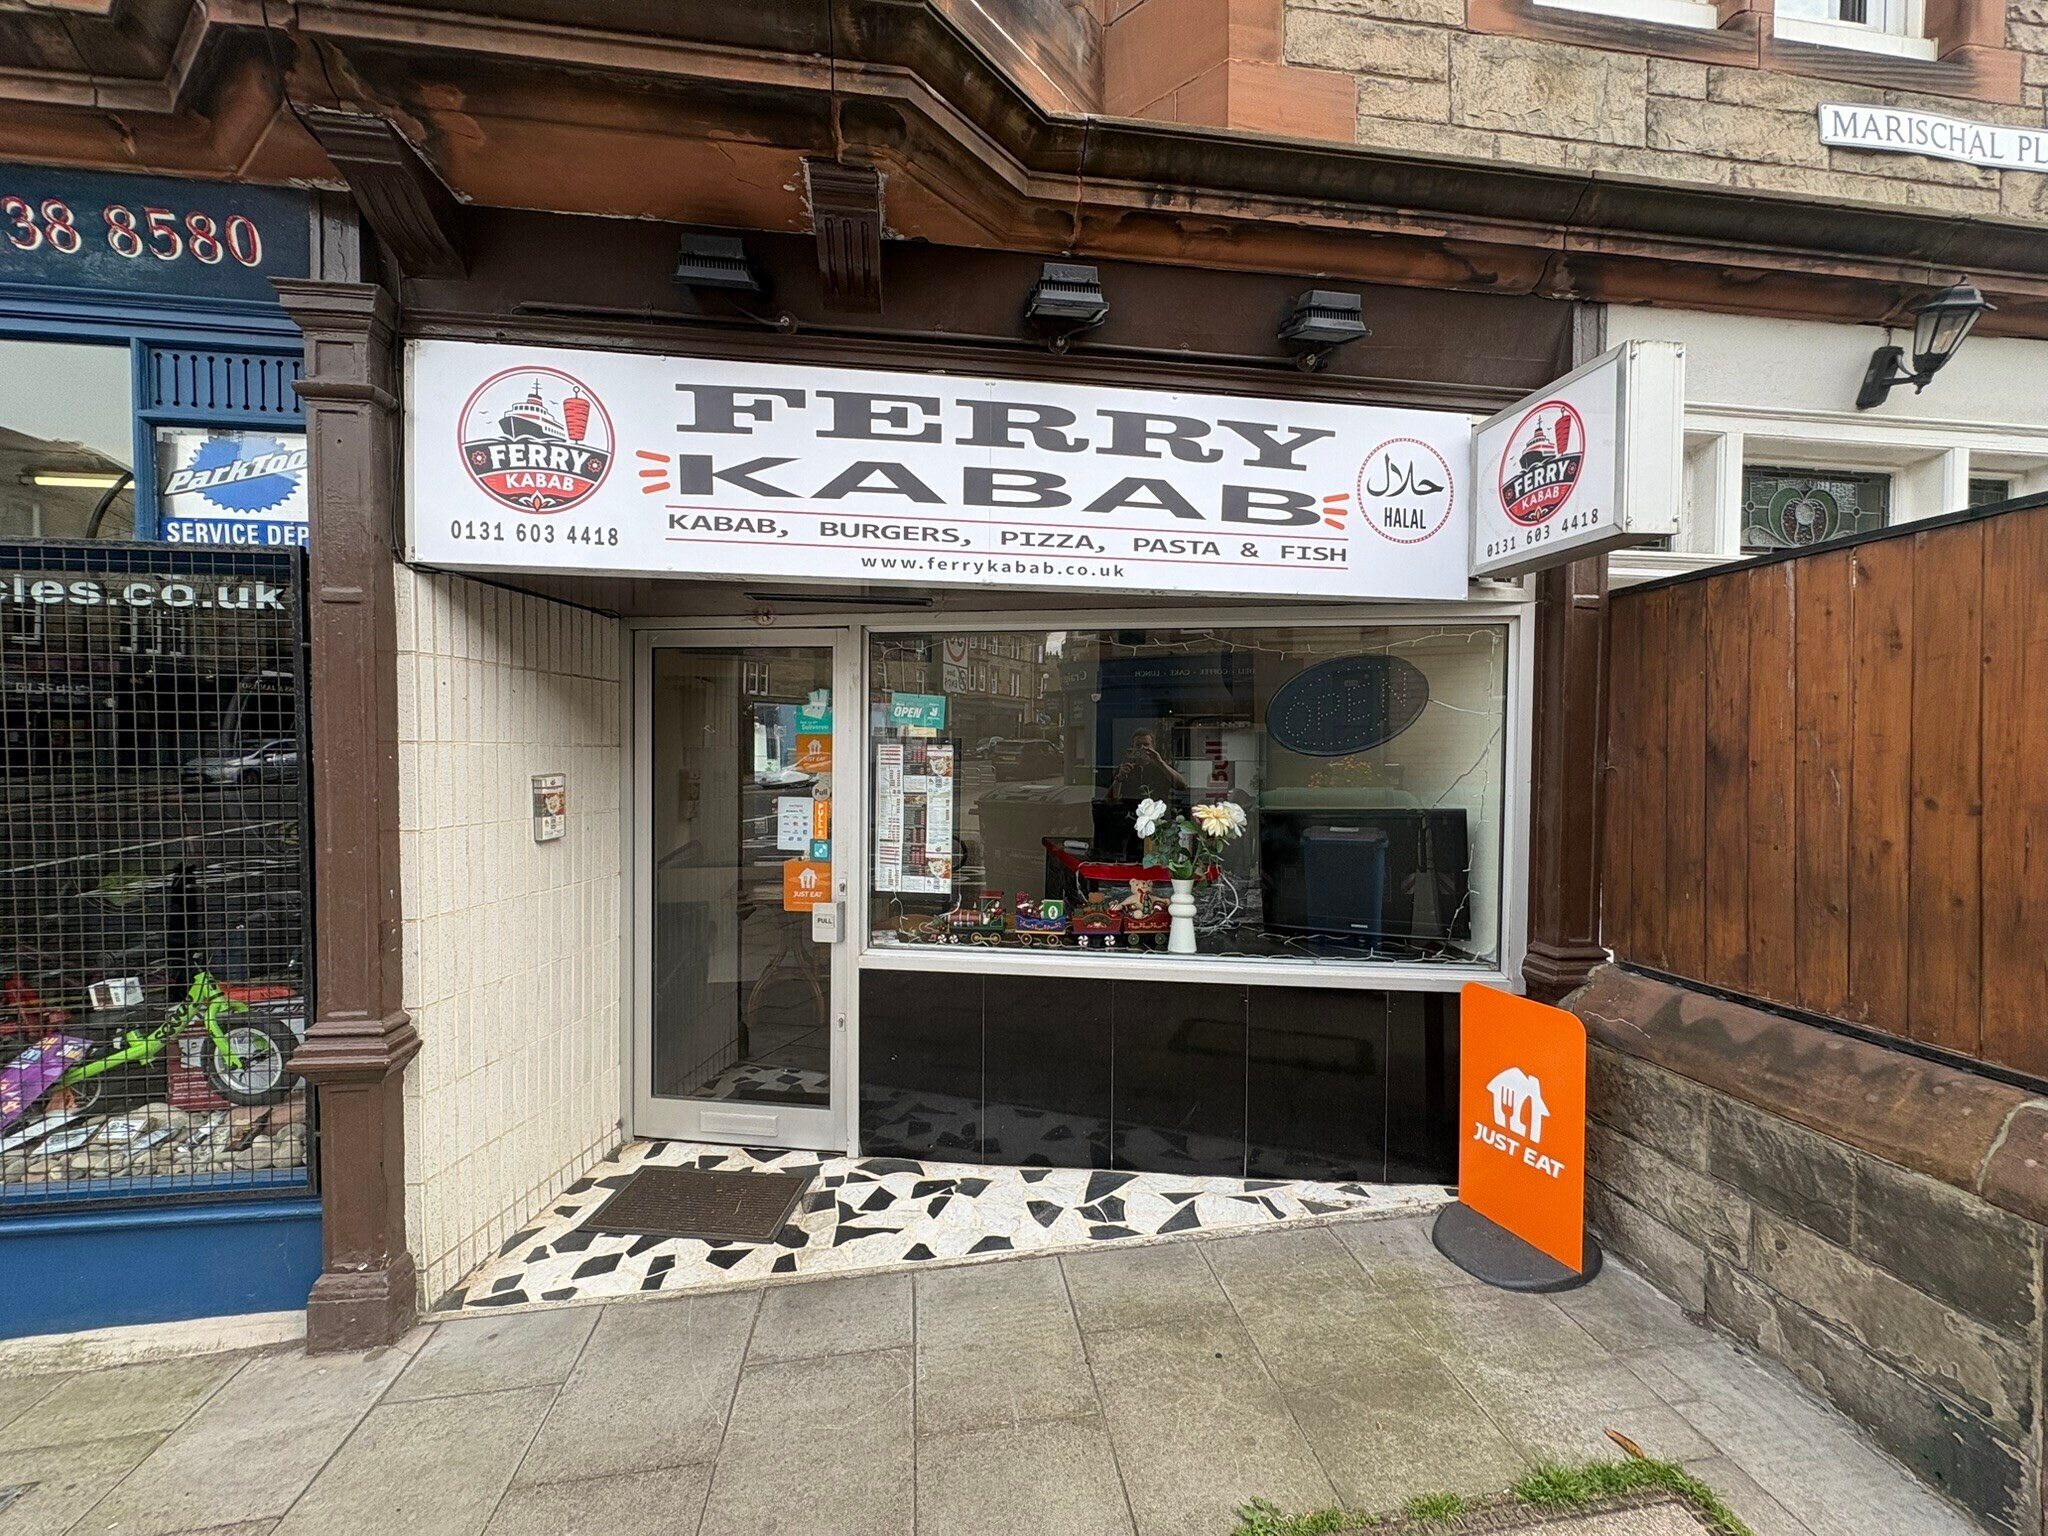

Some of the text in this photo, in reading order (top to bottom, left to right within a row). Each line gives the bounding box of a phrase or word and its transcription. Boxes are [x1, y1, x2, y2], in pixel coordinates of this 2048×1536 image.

[1833, 110, 2004, 158] MARISCHAL
[103, 203, 262, 267] 8580
[675, 383, 1336, 472] FERRY
[489, 444, 591, 475] FERRY
[505, 473, 574, 491] KABAB
[679, 454, 1322, 528] KABAB
[1513, 457, 1570, 498] FERRY
[1521, 484, 1561, 511] KABAB
[166, 522, 259, 545] SERVICE
[450, 519, 619, 547] 0131 603 4418
[1384, 507, 1426, 530] HALAL
[1486, 507, 1600, 558] 0131 603 4418
[668, 513, 1348, 563] KABAB, BURGERS, PIZZA, PASTA & FISH
[860, 556, 1125, 578] www.ferrykabab.co.uk
[0, 574, 286, 611] les.co.uk
[893, 706, 923, 719] OPEN
[1285, 671, 1407, 738] OPEN
[814, 788, 828, 796] Pull
[817, 803, 825, 829] PULL
[817, 917, 833, 925] PULL
[1473, 1122, 1565, 1178] JUST EAT
